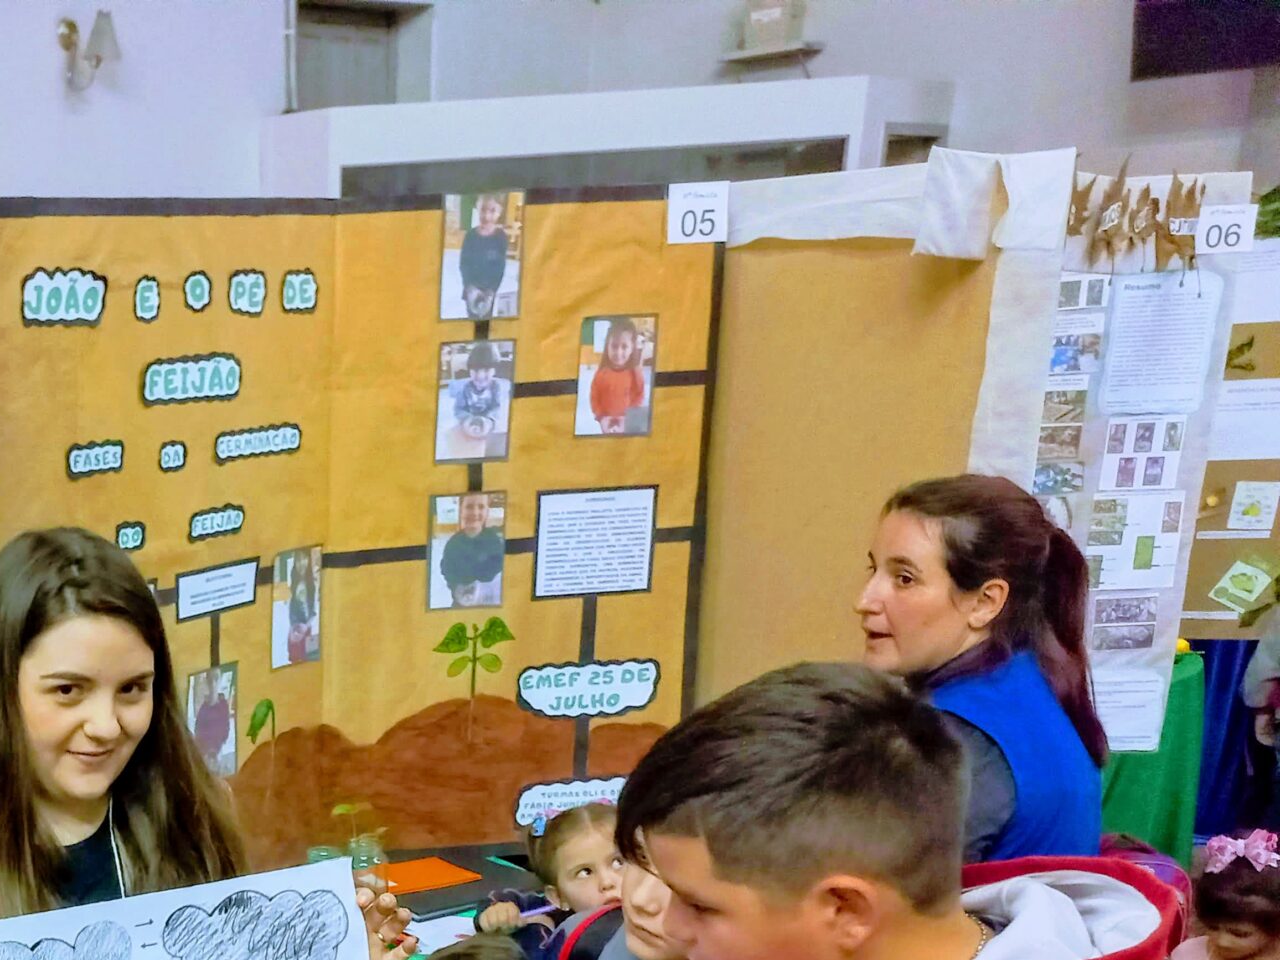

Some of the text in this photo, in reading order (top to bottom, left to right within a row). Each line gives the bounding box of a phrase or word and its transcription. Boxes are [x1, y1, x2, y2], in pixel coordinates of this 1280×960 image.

[681, 208, 716, 237] 05
[1205, 223, 1242, 248] 06
[25, 276, 313, 316] JOÃO E O PÉ DE
[148, 359, 238, 397] FEIJÃO
[72, 450, 120, 470] FASES
[163, 450, 182, 467] DA
[121, 528, 141, 546] DO
[522, 667, 651, 690] EMEF 25 DE
[547, 692, 621, 711] JULHO
